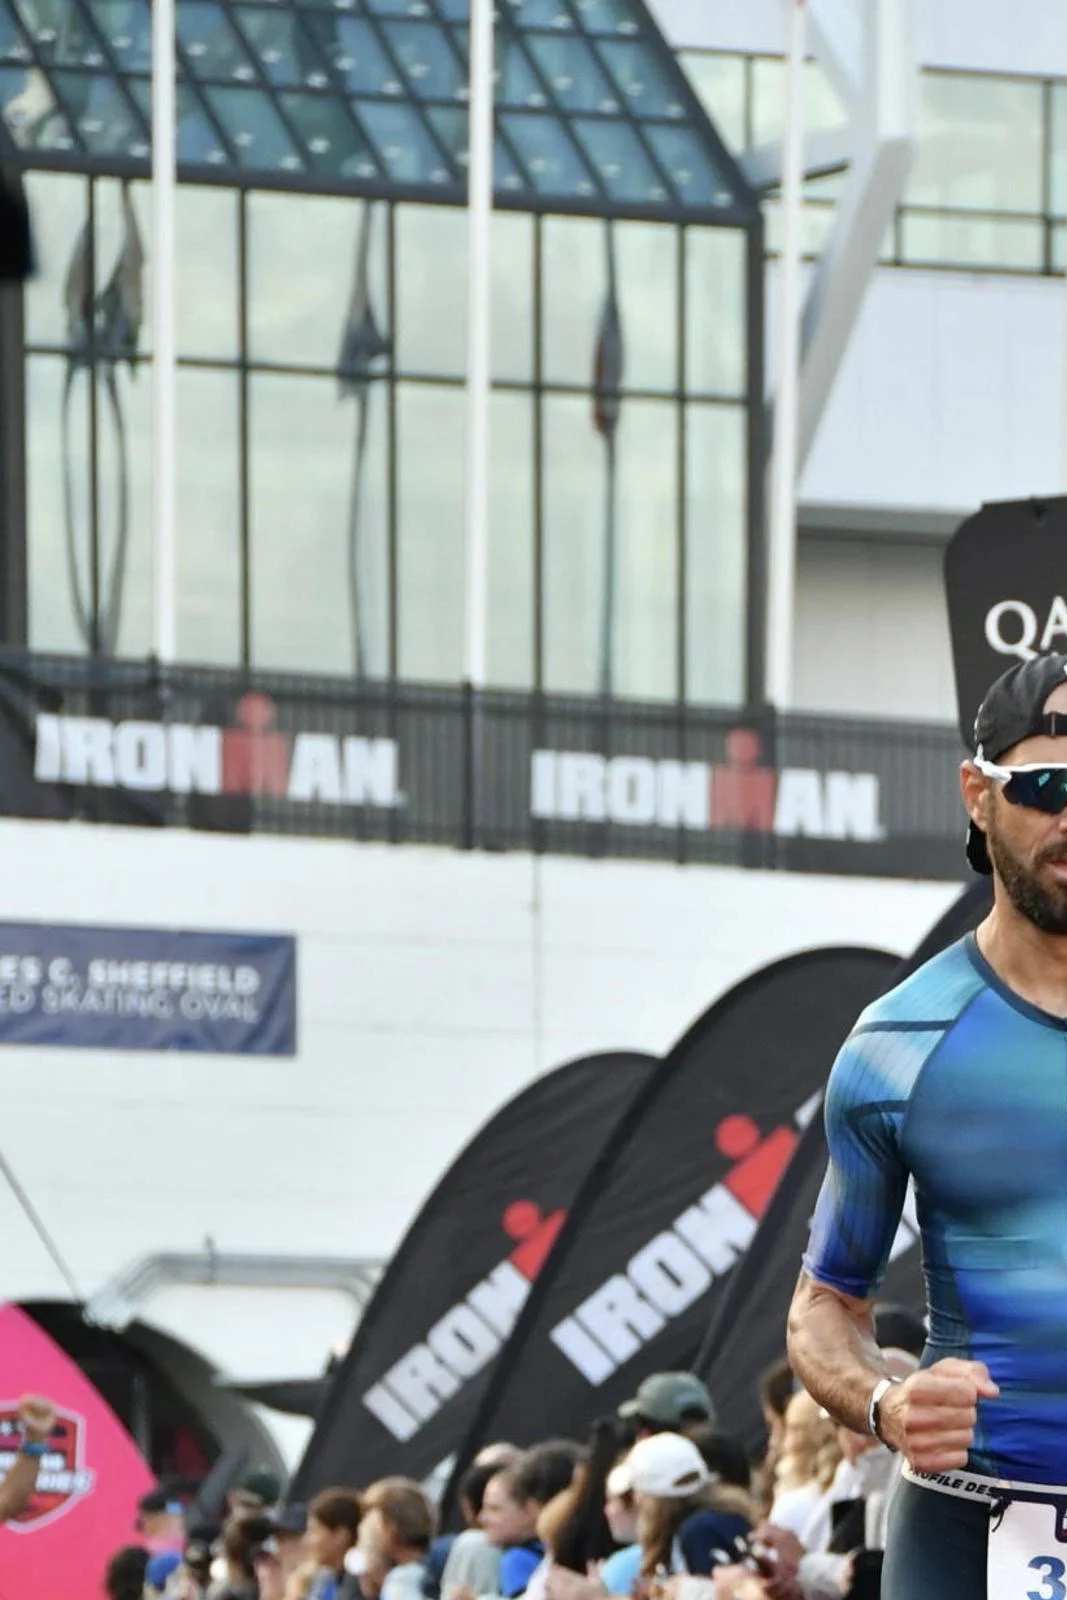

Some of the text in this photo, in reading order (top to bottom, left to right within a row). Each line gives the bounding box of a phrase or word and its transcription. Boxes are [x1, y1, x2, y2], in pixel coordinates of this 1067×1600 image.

[34, 691, 400, 808] IRONMAN
[530, 728, 880, 842] IRONMAN
[88, 959, 260, 996] SHEFFIELD
[180, 989, 259, 1024] OVAL
